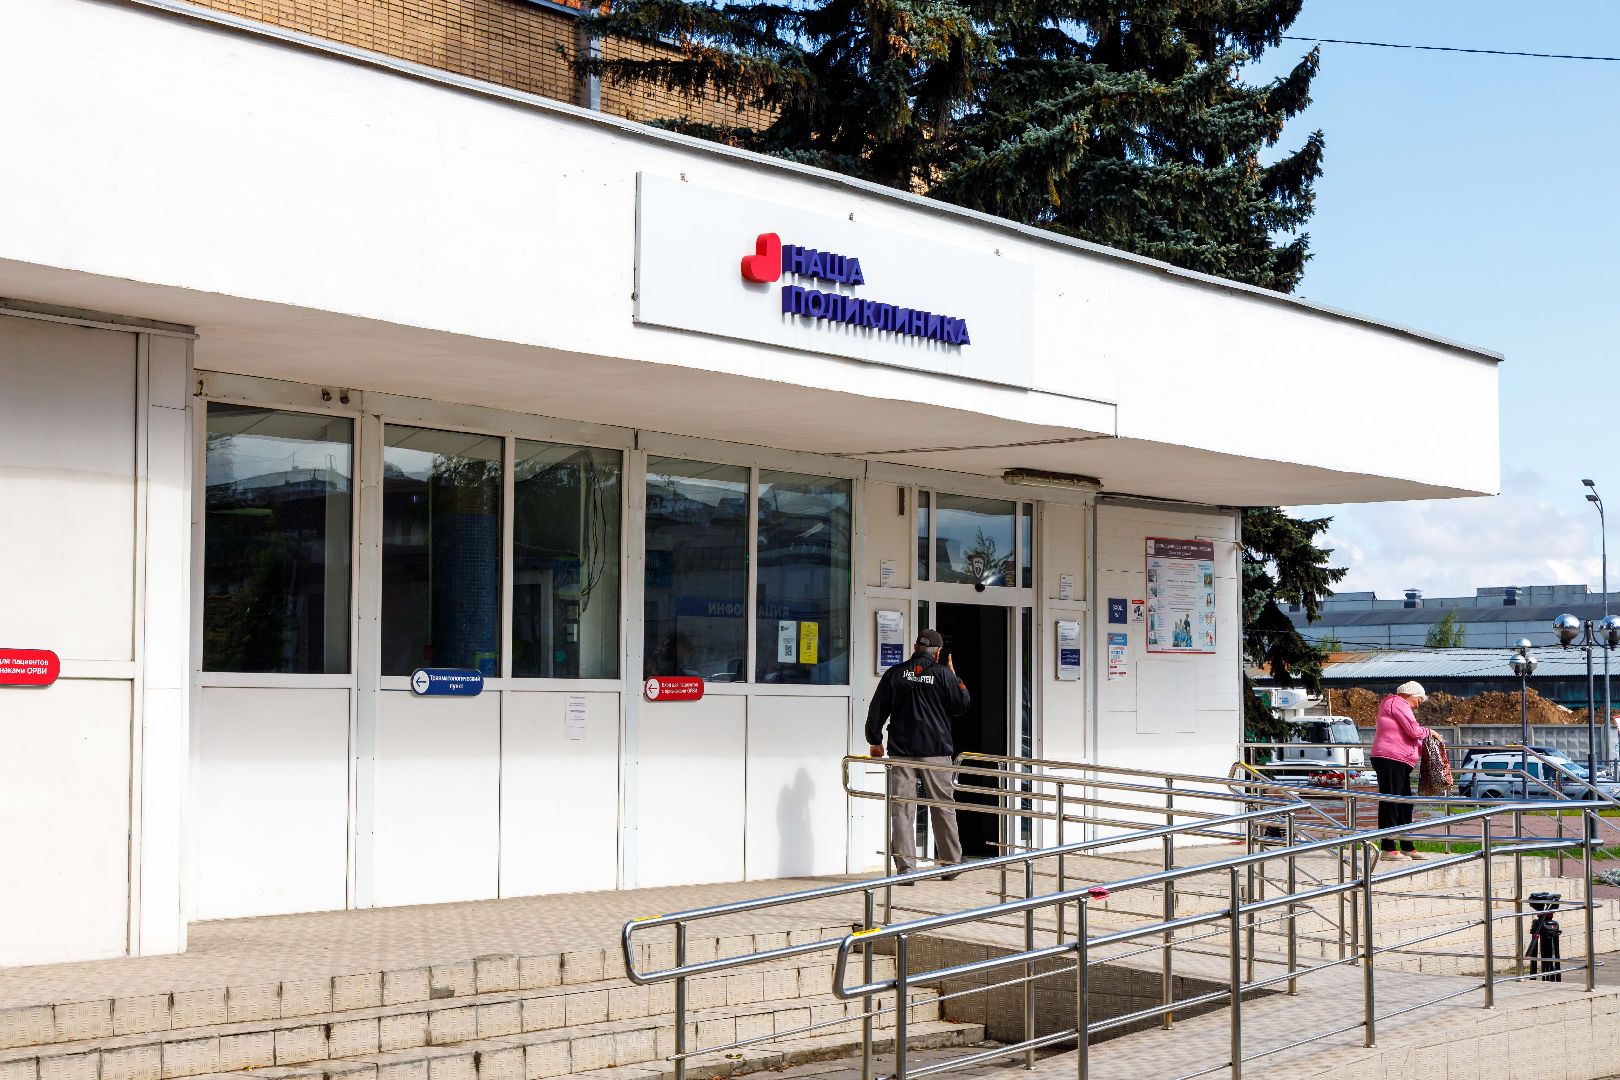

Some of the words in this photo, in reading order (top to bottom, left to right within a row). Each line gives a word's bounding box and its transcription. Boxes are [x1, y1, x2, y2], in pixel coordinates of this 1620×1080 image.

[782, 244, 865, 285] НАША
[782, 285, 971, 345] ПОЛИКЛИНИКА
[11, 658, 49, 666] пациентов
[26, 667, 48, 675] ОРВИ
